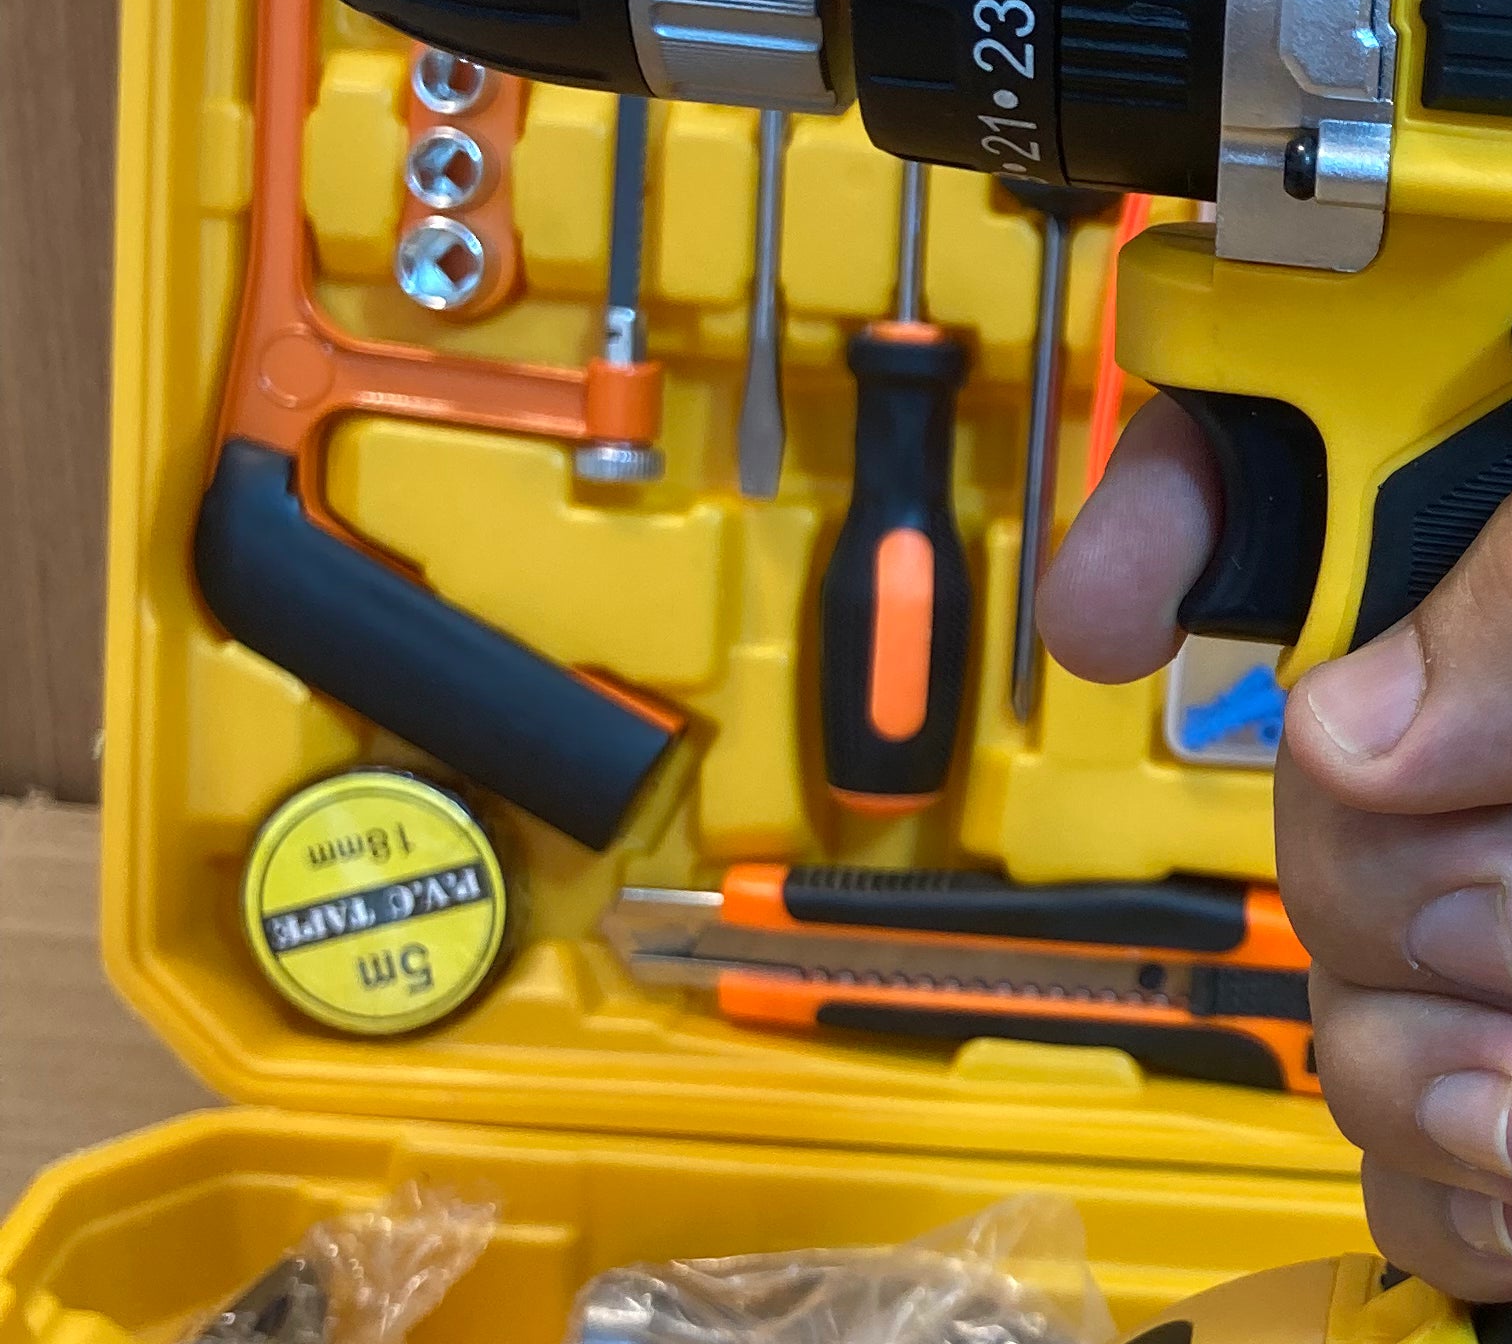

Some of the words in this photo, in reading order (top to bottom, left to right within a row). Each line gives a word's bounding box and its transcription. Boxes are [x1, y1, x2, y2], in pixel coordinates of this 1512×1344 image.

[307, 822, 416, 867] 18mm
[269, 897, 376, 952] TAPE
[357, 941, 435, 995] 5m
